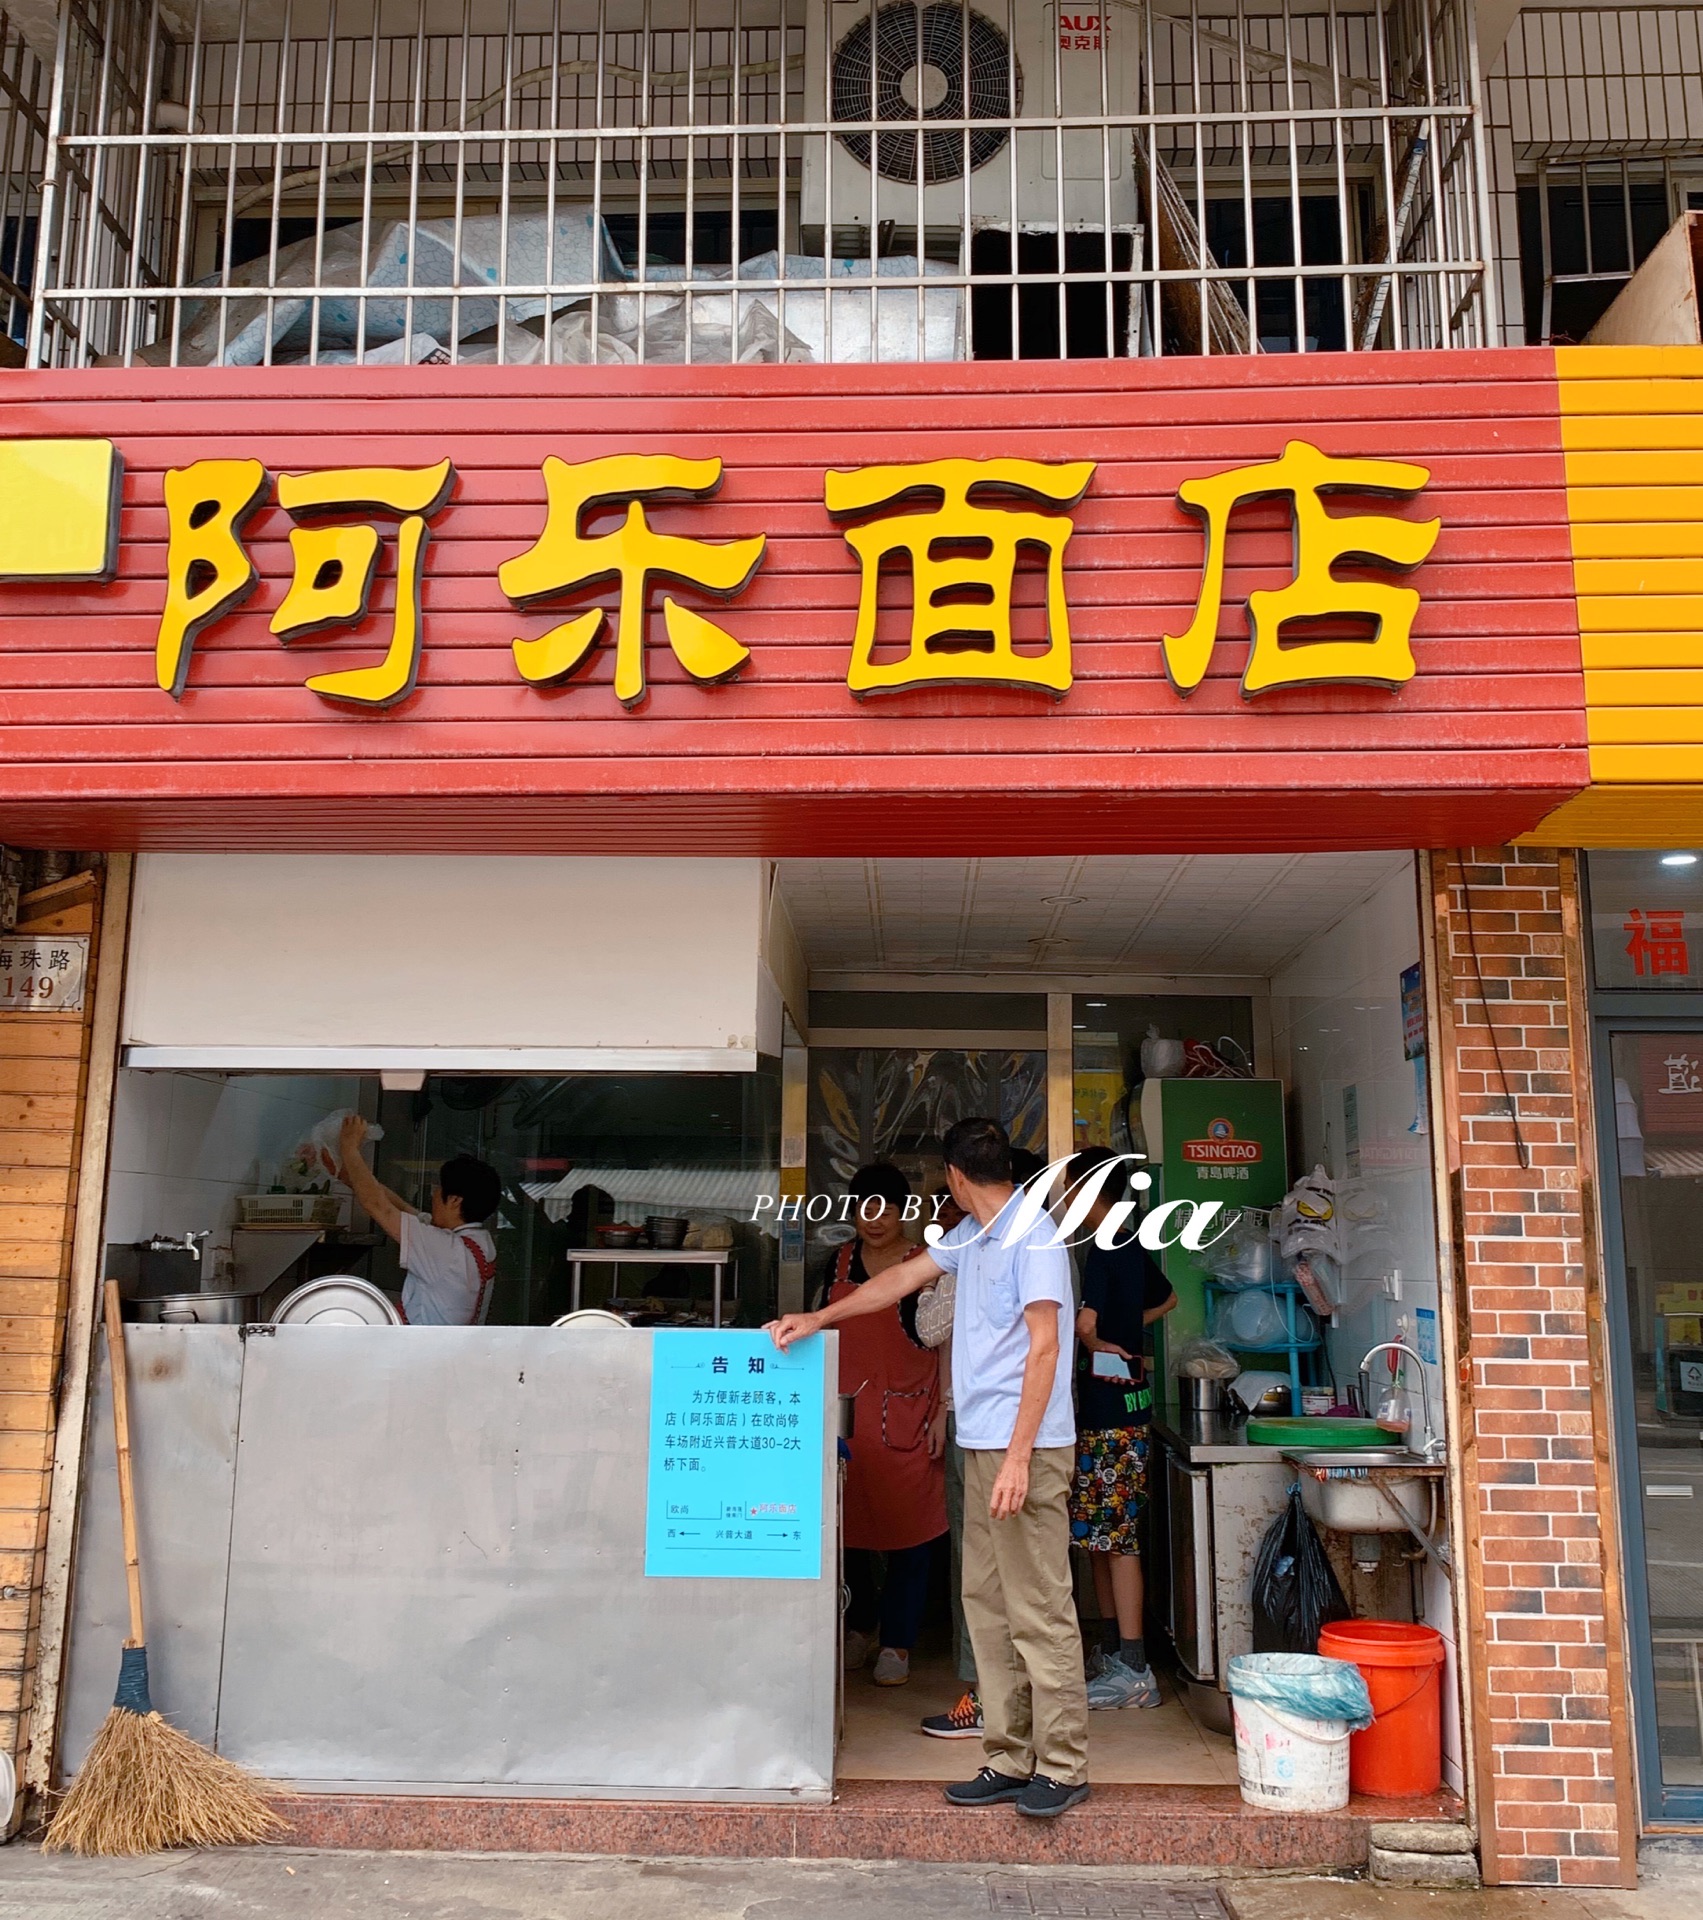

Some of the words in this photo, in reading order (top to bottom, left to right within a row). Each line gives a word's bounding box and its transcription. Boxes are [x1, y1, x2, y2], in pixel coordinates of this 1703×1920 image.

[155, 439, 1442, 706] 阿乐面店
[1623, 908, 1690, 977] 福
[2, 976, 54, 999] 149
[1187, 1144, 1257, 1159] TSINGTAO
[1195, 1166, 1250, 1181] 青岛啤酒
